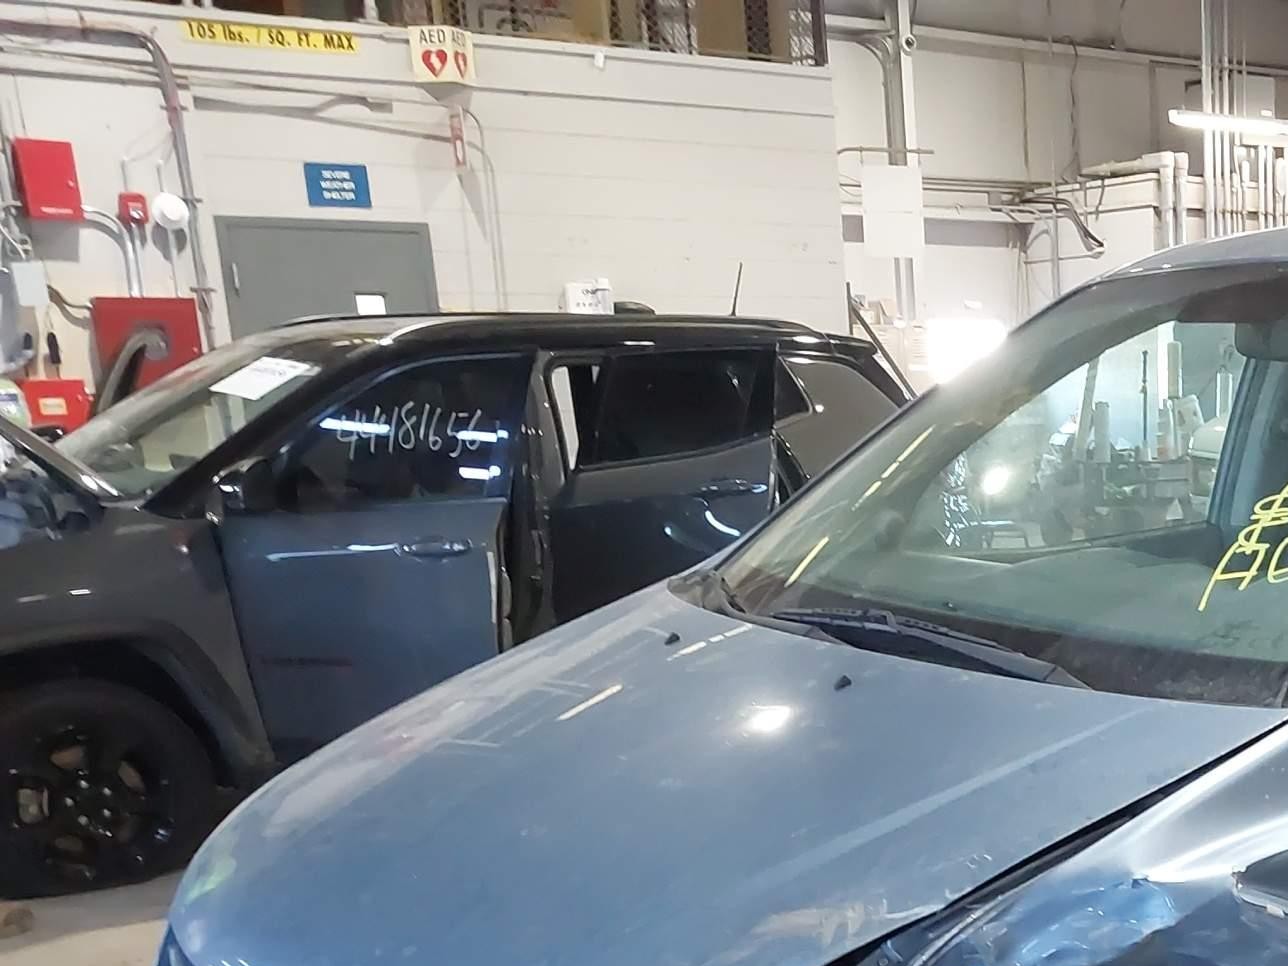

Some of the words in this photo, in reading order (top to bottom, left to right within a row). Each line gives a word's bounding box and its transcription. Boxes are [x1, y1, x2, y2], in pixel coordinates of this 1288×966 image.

[187, 21, 216, 40] 105
[222, 23, 250, 44] lbs.
[267, 28, 291, 46] SQ.
[297, 31, 317, 49] FT.
[323, 33, 355, 51] MAX
[420, 29, 446, 44] AED
